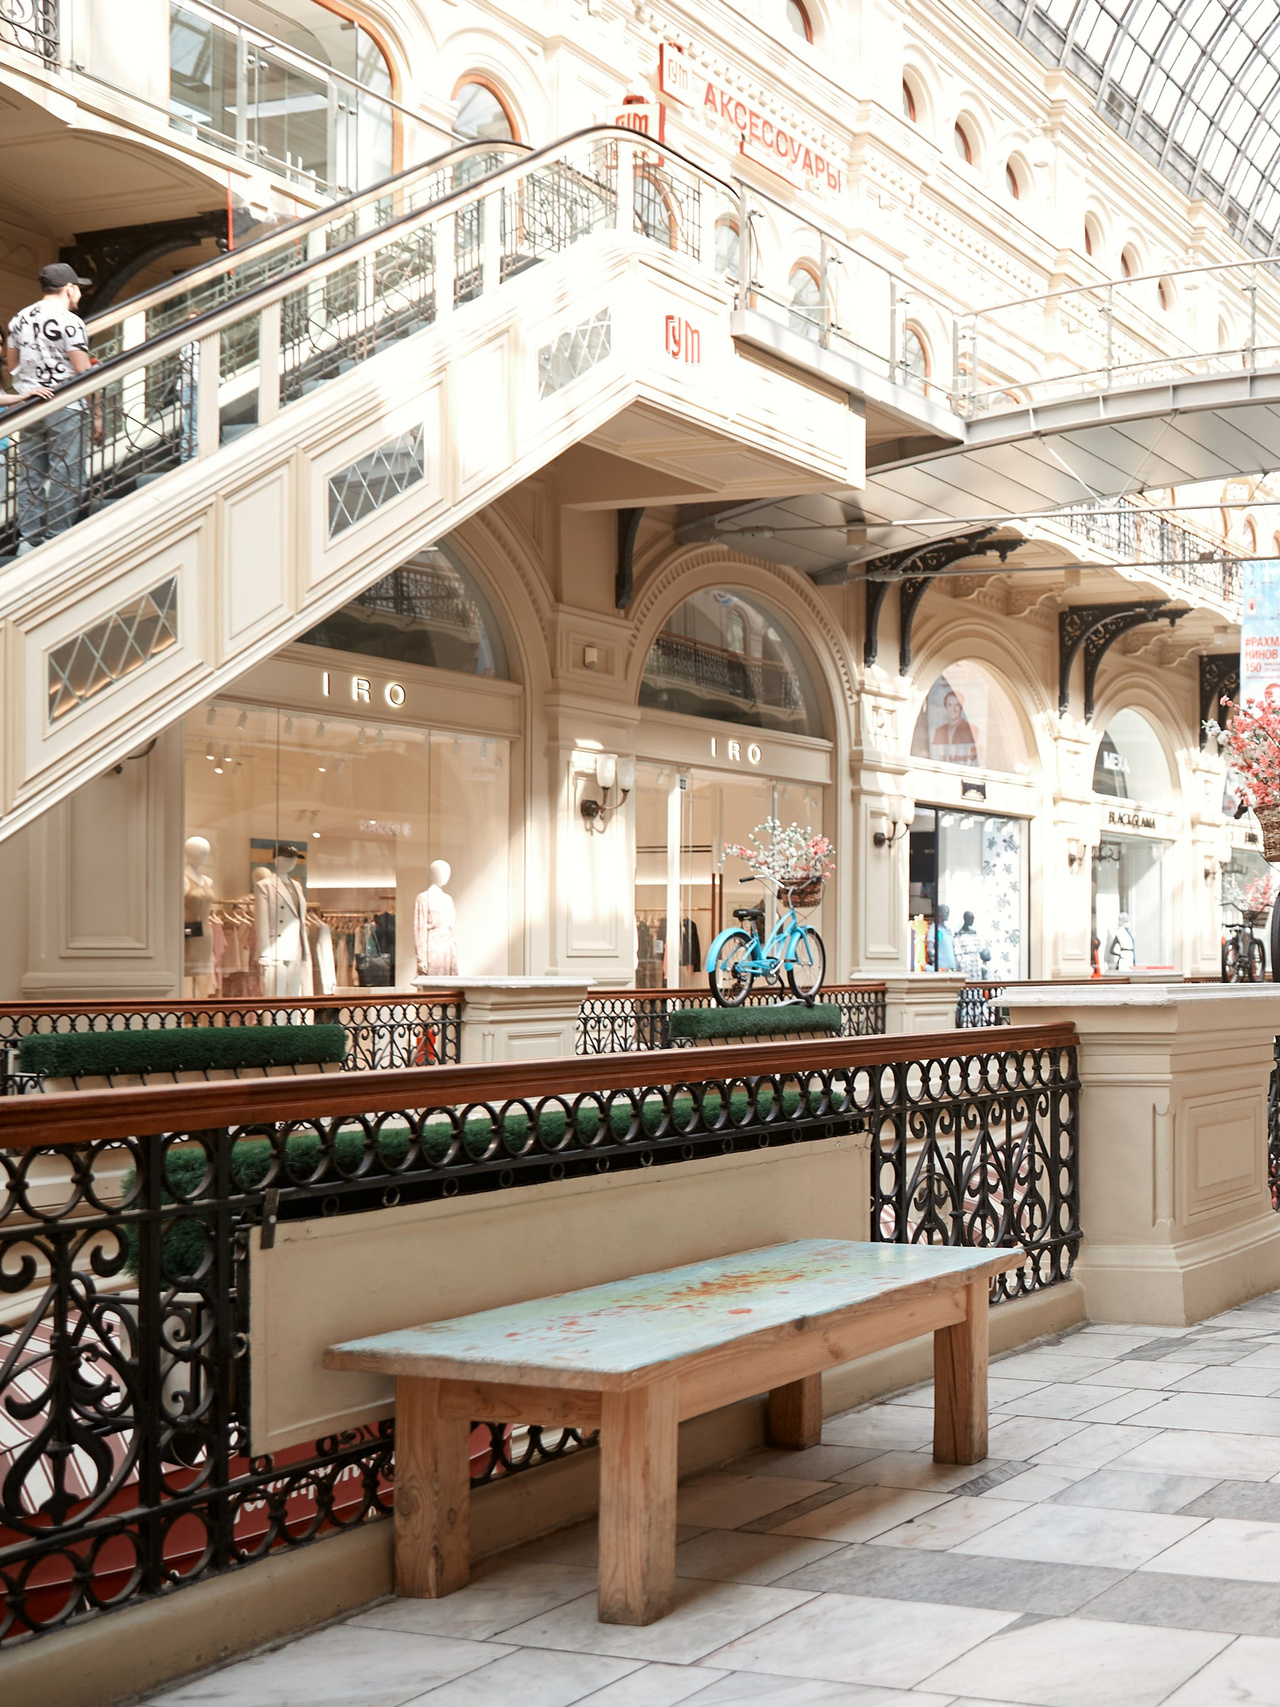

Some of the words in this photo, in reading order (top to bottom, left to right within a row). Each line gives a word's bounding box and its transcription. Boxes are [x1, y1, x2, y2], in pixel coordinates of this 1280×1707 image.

[703, 82, 841, 193] АКСЕССУАРЫ
[1245, 649, 1278, 660] НИНОВ
[1246, 662, 1262, 673] 150
[323, 672, 407, 708] IRO
[711, 737, 763, 765] IRO
